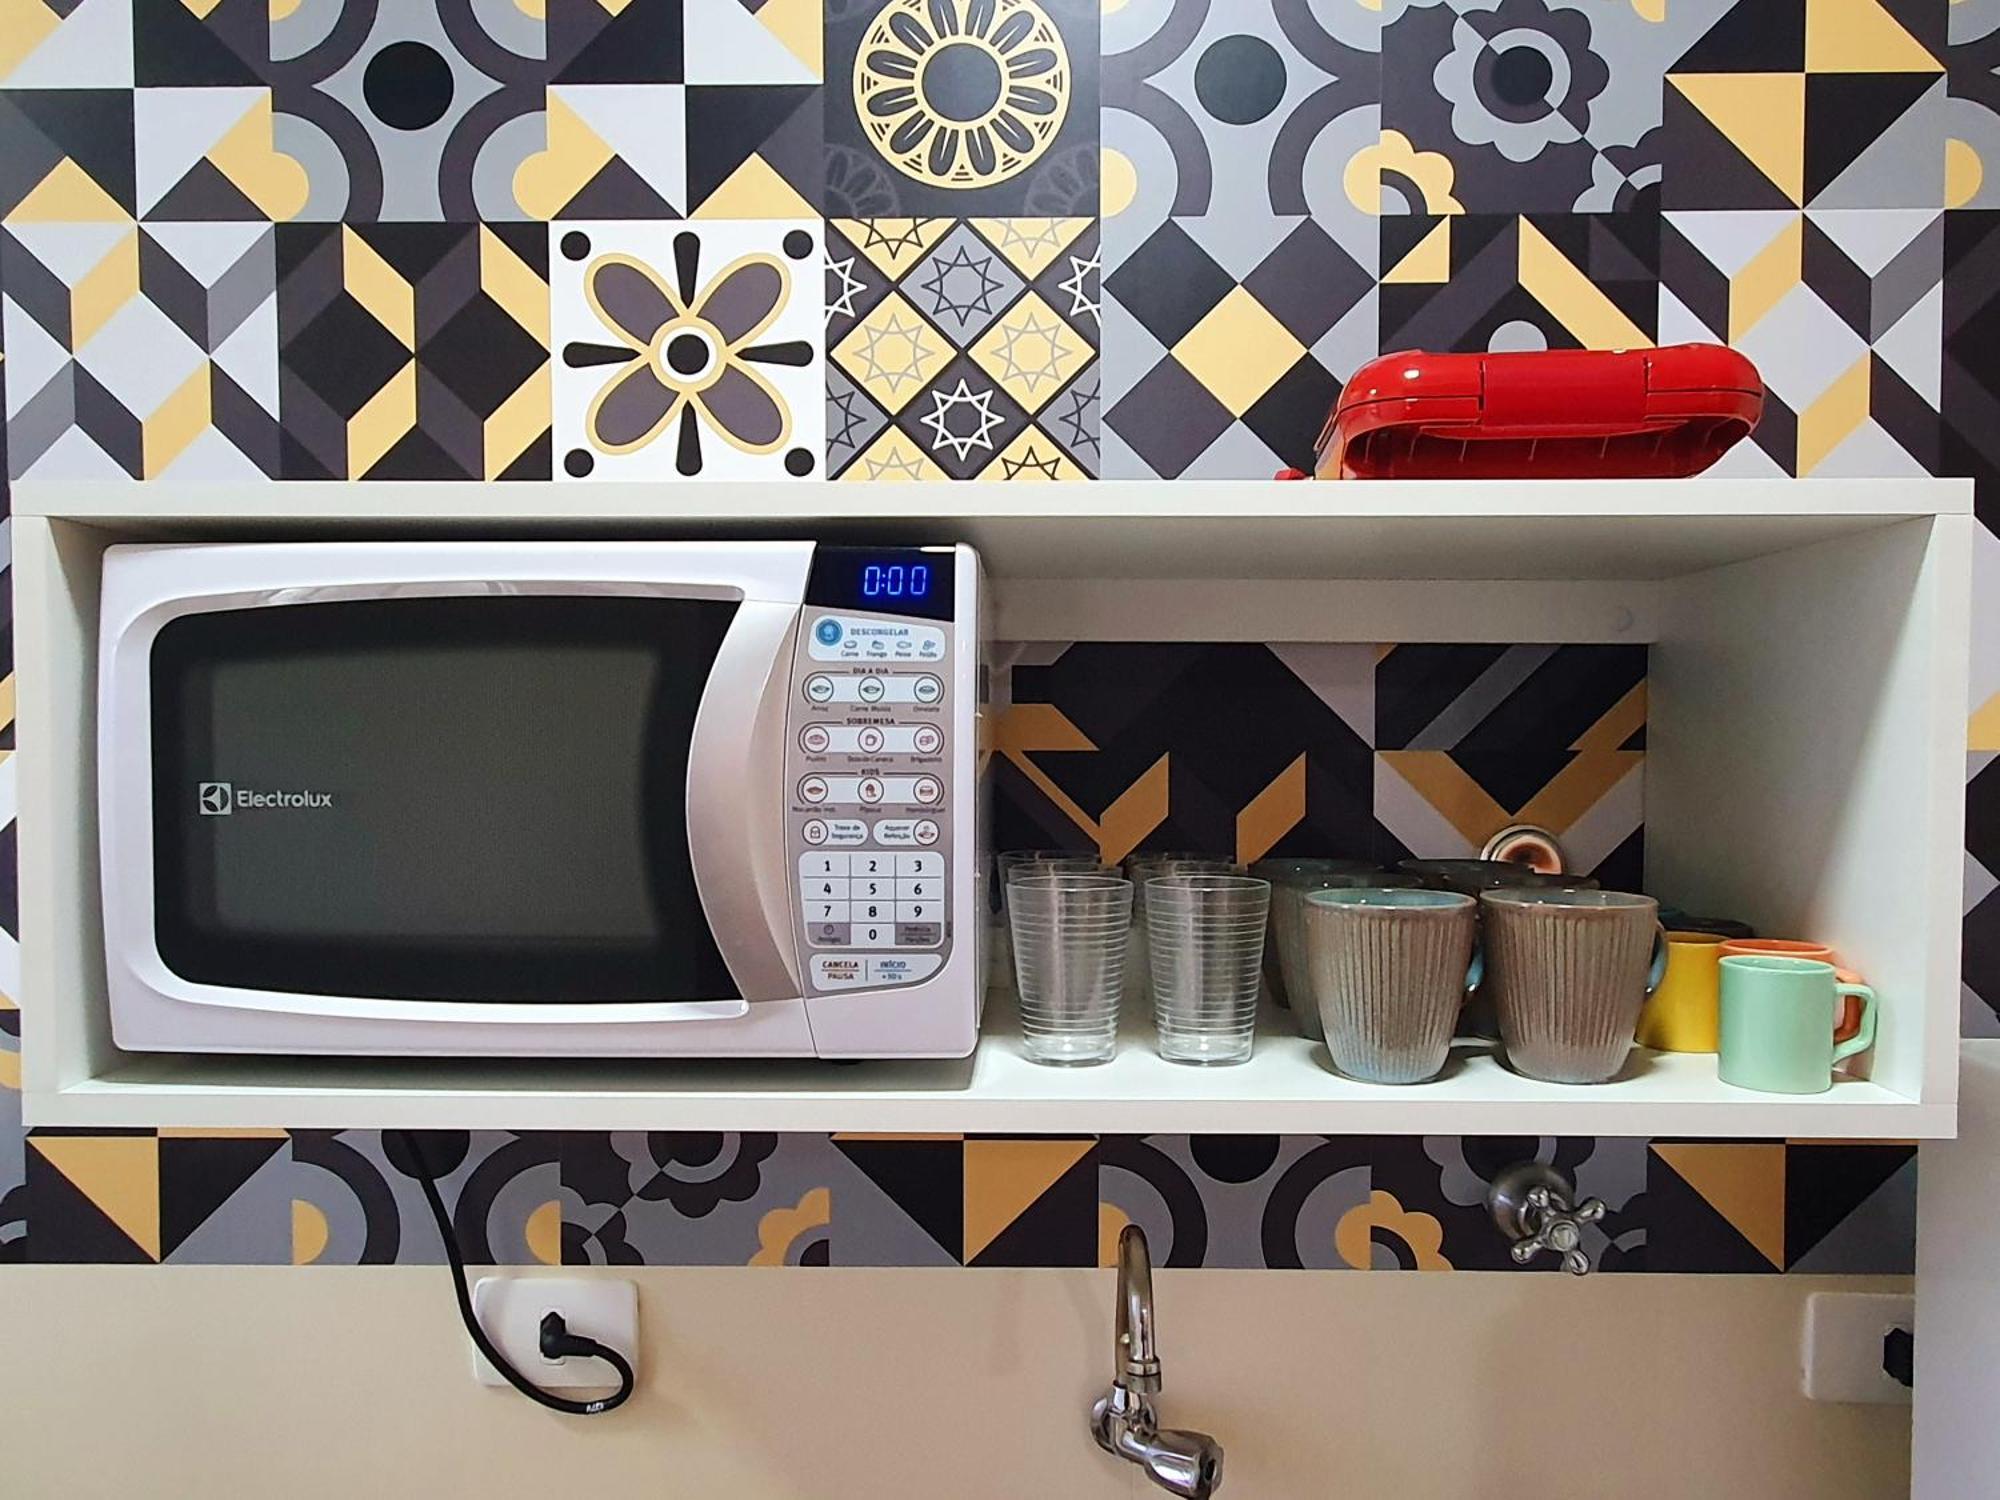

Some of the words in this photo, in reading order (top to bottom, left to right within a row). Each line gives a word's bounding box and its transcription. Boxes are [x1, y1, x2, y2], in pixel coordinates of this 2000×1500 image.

[864, 565, 927, 596] 0:00
[850, 628, 909, 636] DESCONGELAR
[236, 789, 332, 808] Electrolux
[825, 860, 831, 872] 1
[869, 860, 877, 872] 2
[914, 860, 922, 872] 3
[823, 882, 831, 895] 4
[869, 883, 877, 895] 5
[914, 883, 922, 895] 6
[824, 905, 831, 917] 7
[868, 905, 877, 917] 8
[914, 905, 922, 917] 9
[869, 929, 877, 940] 0
[822, 960, 859, 968] CANCELA
[880, 959, 906, 968] INÍCIO
